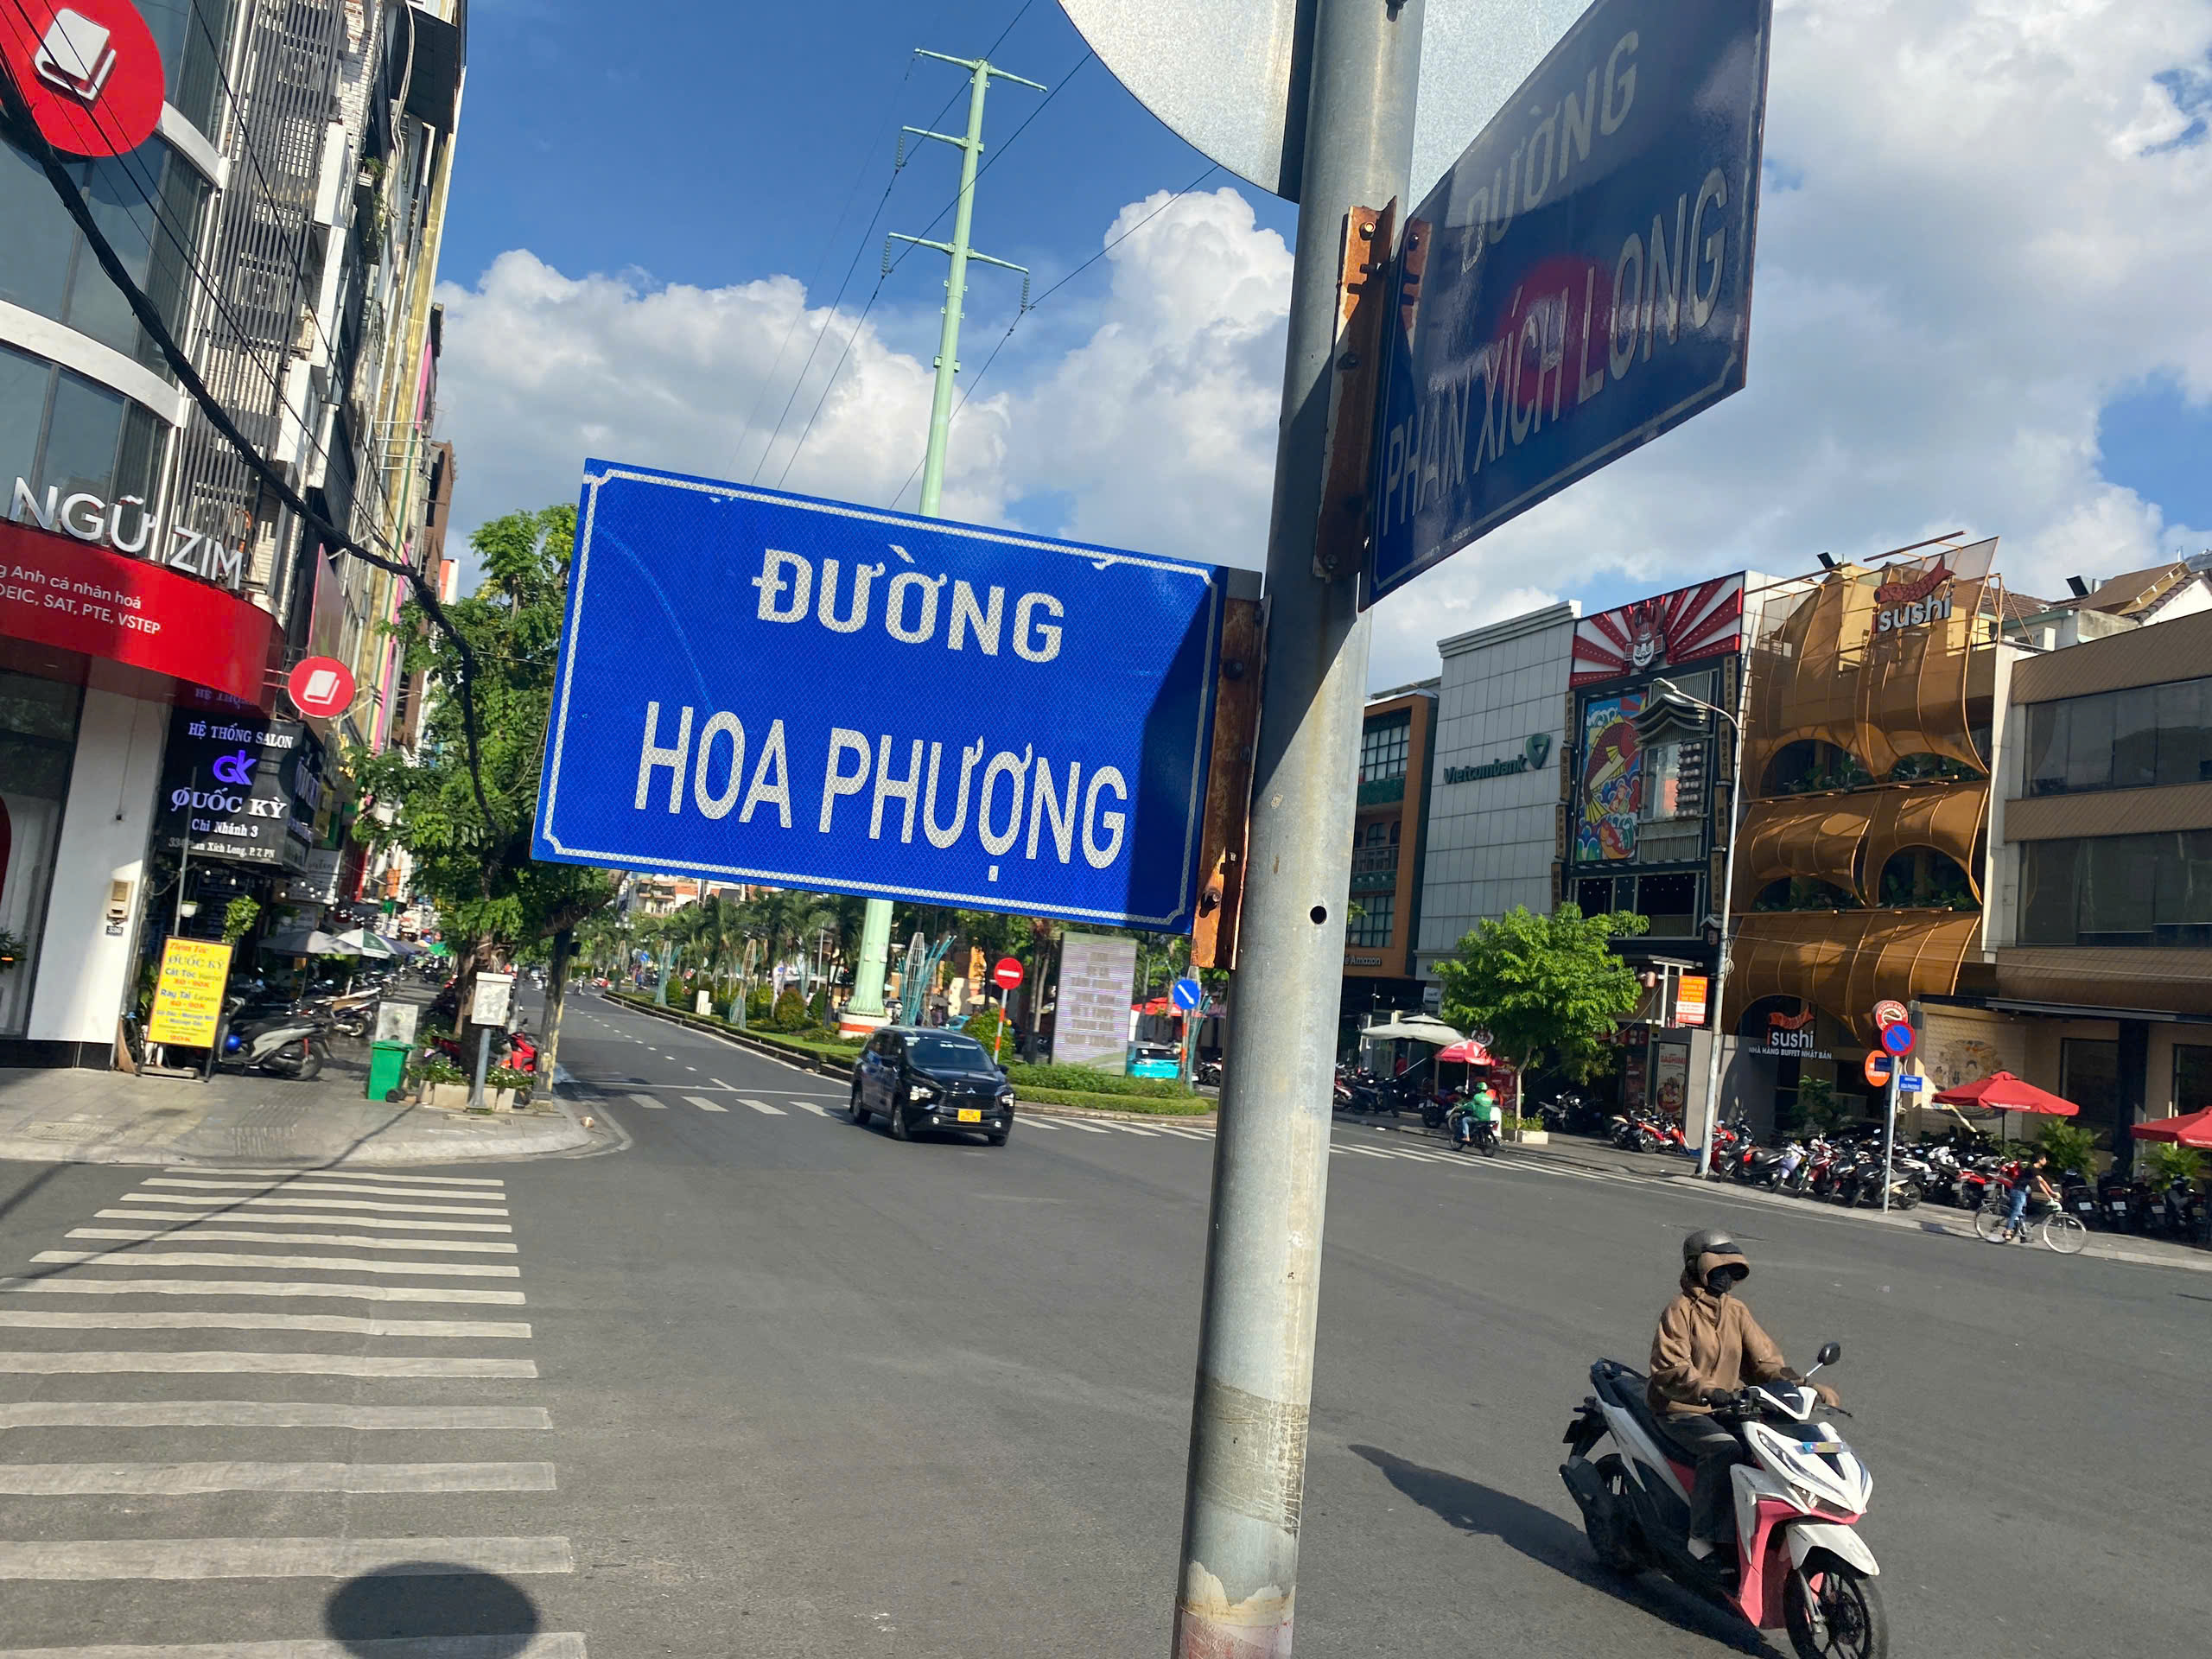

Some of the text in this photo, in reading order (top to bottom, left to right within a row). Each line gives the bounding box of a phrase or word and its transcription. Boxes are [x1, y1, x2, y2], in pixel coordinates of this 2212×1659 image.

[1382, 168, 1728, 537] PHAN XÍCH LONG
[10, 476, 244, 591] NGỮ ZIM
[10, 565, 46, 584] Anh
[73, 581, 112, 602] nhân
[43, 594, 78, 616] SAT,
[82, 605, 114, 625] PTE,
[118, 613, 162, 635] VSTEP
[750, 543, 1065, 664] ĐƯỜNG
[188, 721, 294, 749] HỆ THỐNG SALON
[1444, 753, 1529, 785] Vietcombank
[633, 700, 1128, 882] HOA PHƯỢNG
[248, 796, 288, 819] KỲ
[192, 818, 259, 838] Chi Nhánh 3
[207, 842, 226, 853] Xích
[1350, 955, 1381, 965] Amazon
[1748, 1046, 1762, 1054] NHÀ
[1762, 1046, 1780, 1056] HÀNG
[1780, 1048, 1801, 1058] BUFFET
